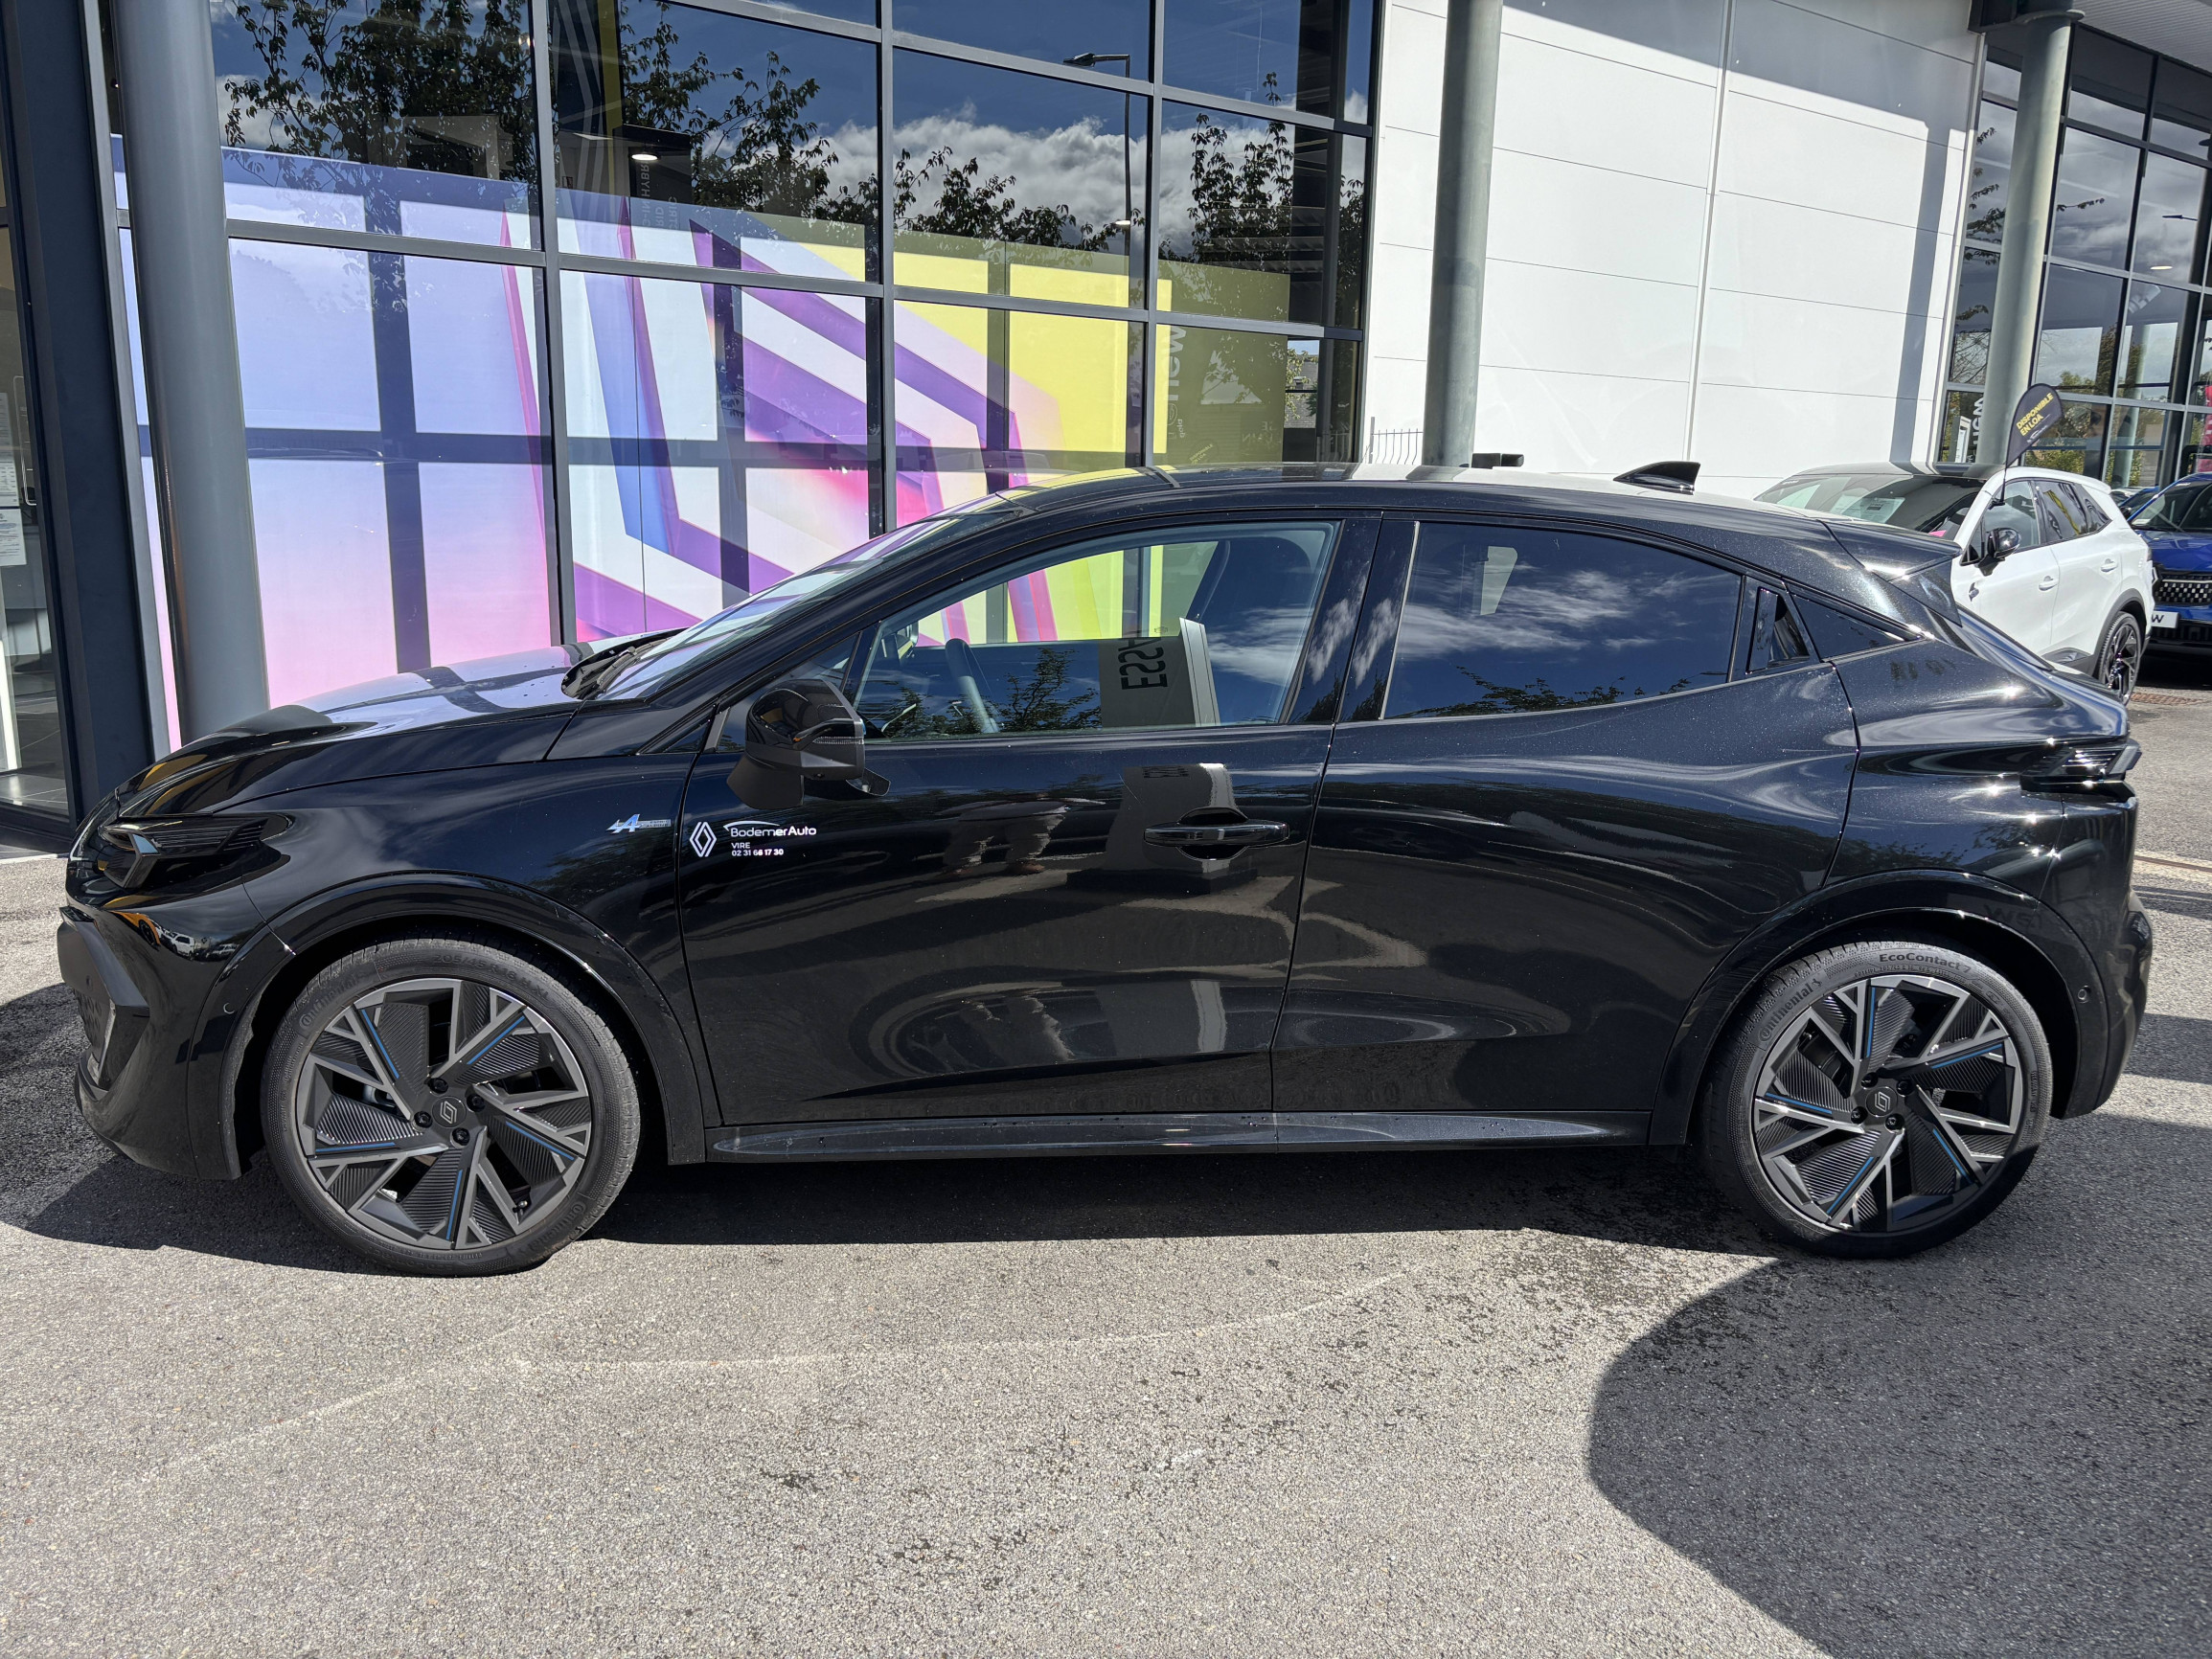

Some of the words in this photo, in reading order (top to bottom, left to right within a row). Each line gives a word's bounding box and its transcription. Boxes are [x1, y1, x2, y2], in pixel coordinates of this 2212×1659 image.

[2017, 393, 2054, 429] DISPONIBLE
[2020, 424, 2031, 436] EN
[2028, 414, 2043, 428] LOA
[730, 826, 818, 837] BodemerAuto
[1879, 952, 1962, 971] EcoContact
[1963, 965, 1973, 973] 7
[1757, 982, 1814, 1043] Continental
